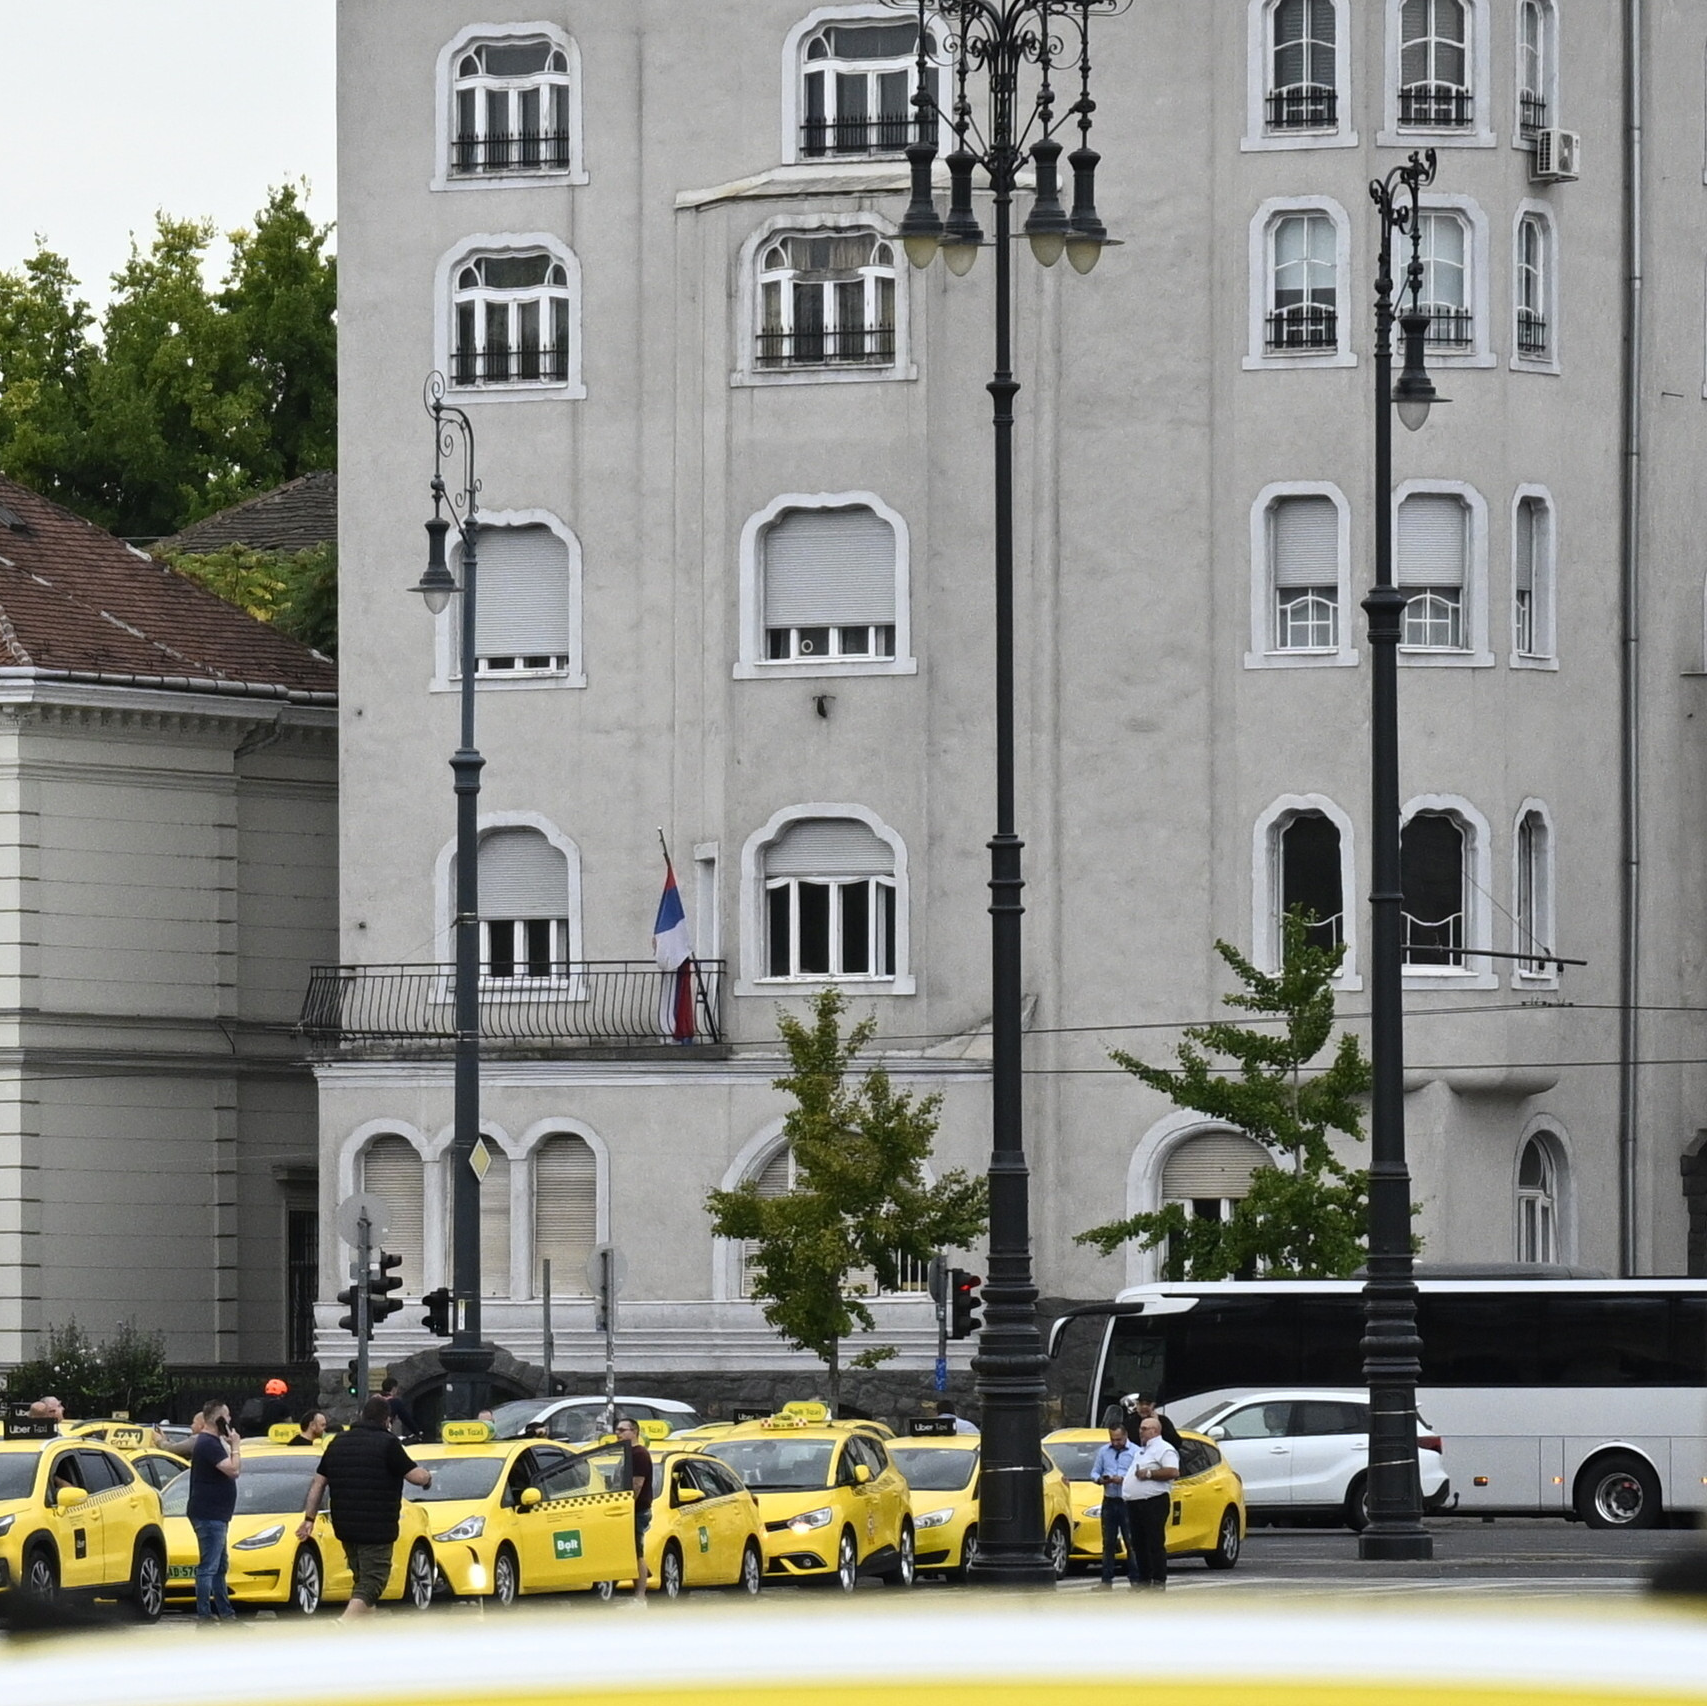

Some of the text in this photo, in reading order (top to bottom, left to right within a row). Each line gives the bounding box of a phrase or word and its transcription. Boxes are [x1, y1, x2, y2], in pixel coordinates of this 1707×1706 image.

[9, 1424, 30, 1434] Uber
[448, 1428, 484, 1438] Bolt Taxi
[647, 1426, 664, 1434] Taxi
[118, 1431, 140, 1442] TAXI
[557, 1538, 579, 1552] Bolt
